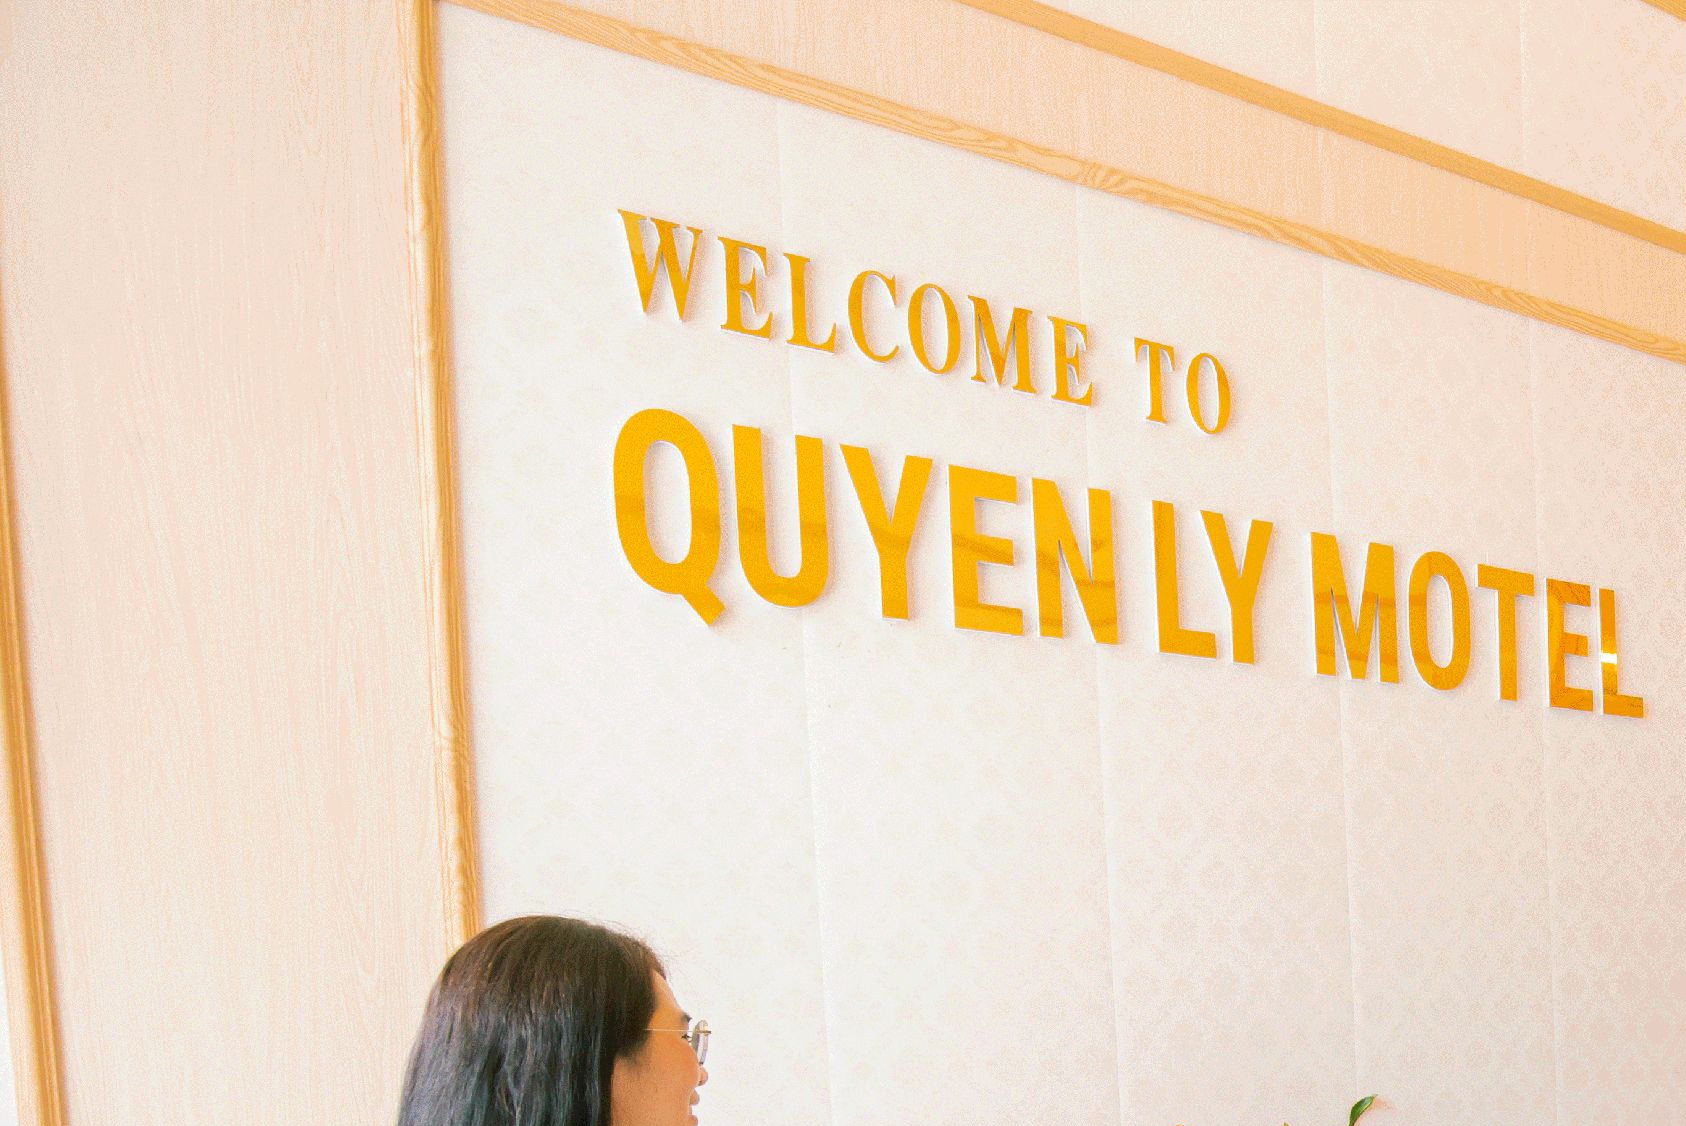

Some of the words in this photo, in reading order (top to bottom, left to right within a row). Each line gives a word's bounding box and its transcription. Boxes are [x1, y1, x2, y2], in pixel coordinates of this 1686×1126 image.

[616, 207, 1096, 408] WELCOME
[1134, 335, 1234, 437] TO
[611, 407, 1121, 647] QUYEN
[1151, 498, 1274, 666] LY
[1310, 531, 1647, 720] MOTEL
